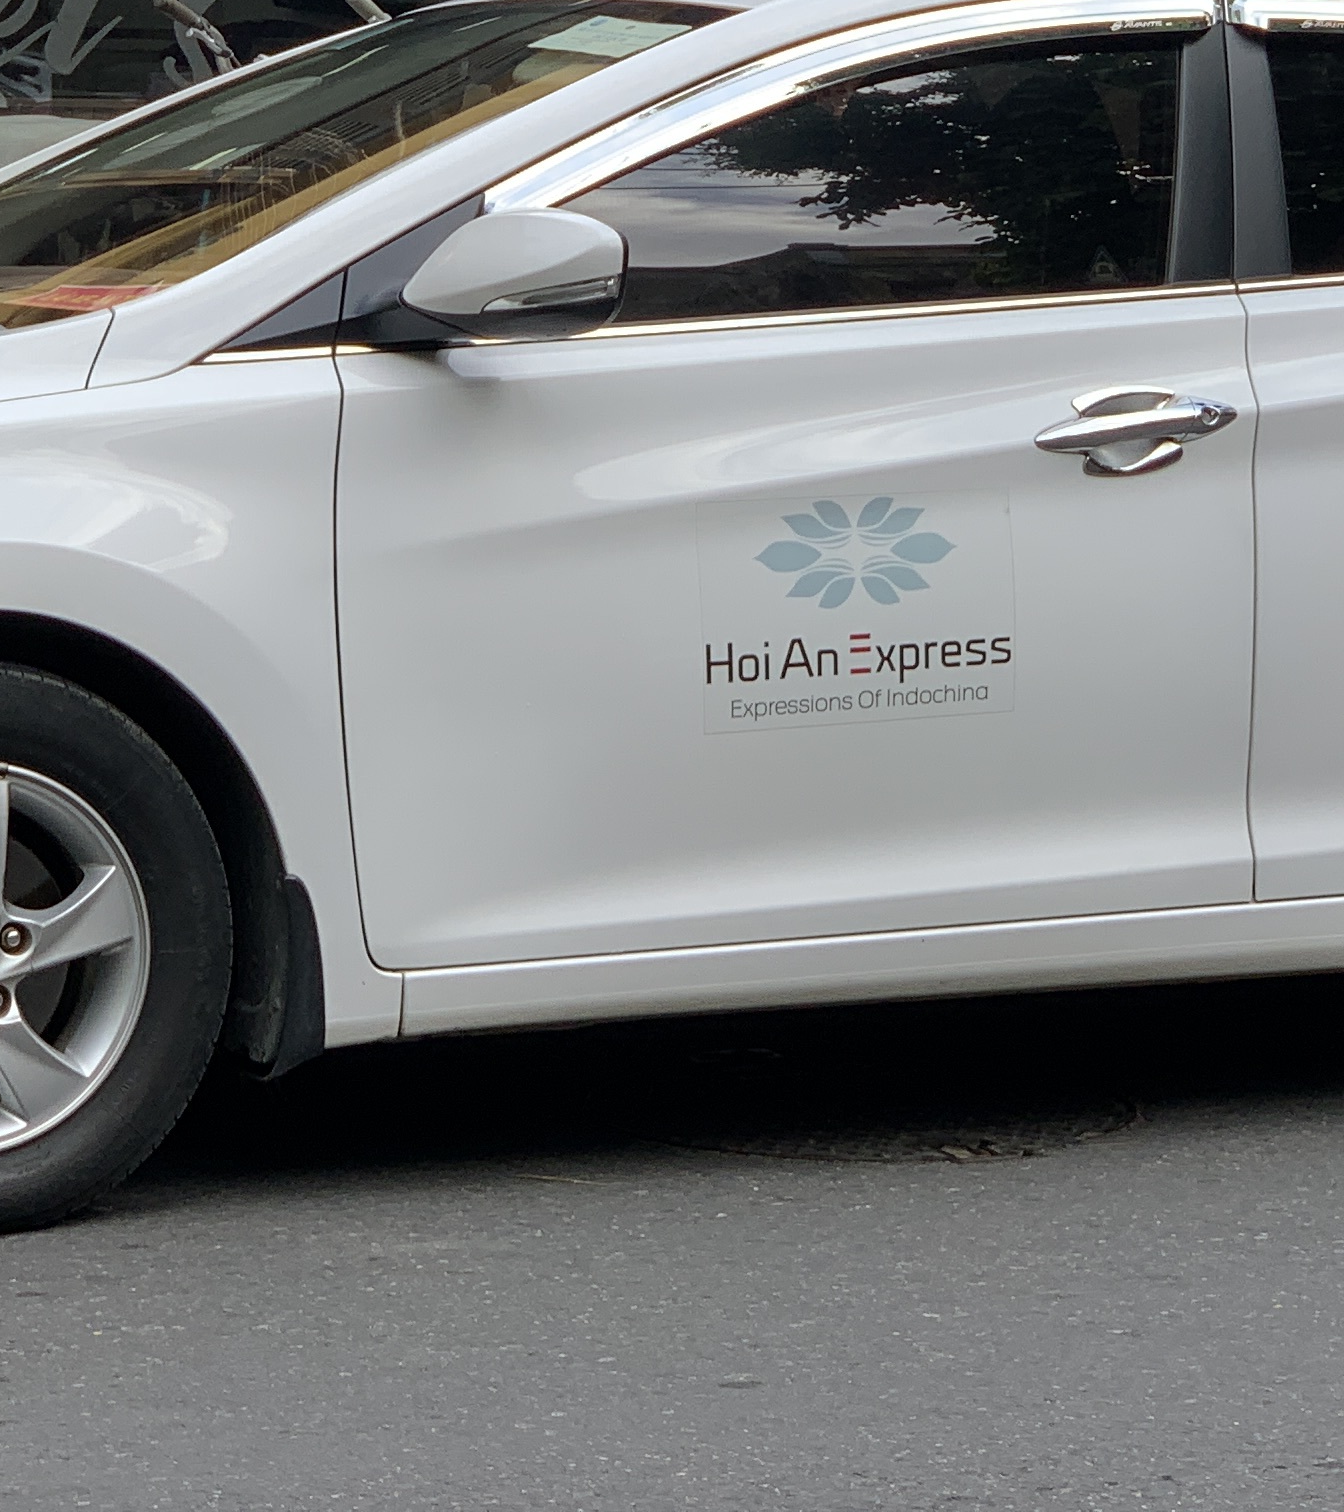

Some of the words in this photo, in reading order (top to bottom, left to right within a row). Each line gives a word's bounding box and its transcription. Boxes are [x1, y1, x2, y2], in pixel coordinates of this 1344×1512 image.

[705, 641, 771, 684] Hoi
[780, 637, 838, 680] An
[849, 632, 1012, 683] Express
[731, 692, 853, 721] Expressions
[857, 689, 884, 710] Of
[886, 684, 989, 708] Indochina
